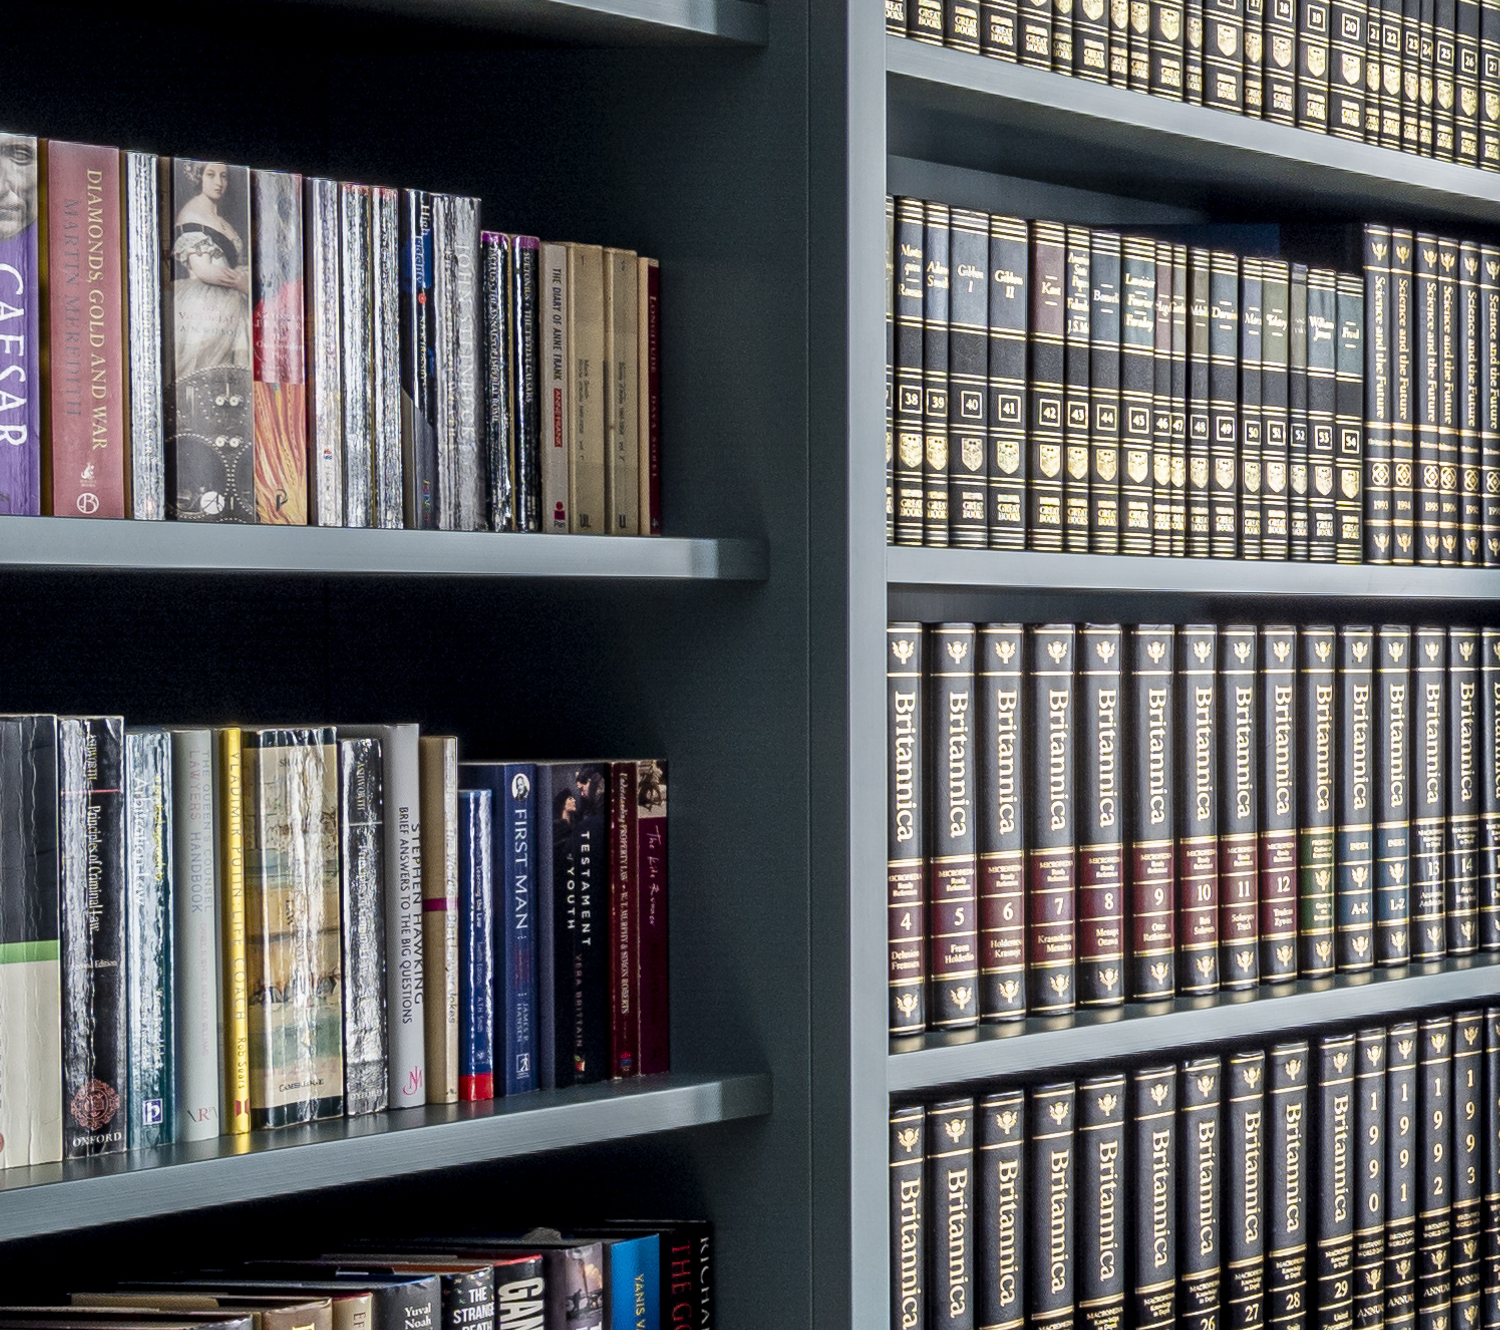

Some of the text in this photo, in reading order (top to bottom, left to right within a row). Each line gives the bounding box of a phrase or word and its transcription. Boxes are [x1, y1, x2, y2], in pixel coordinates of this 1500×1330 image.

[85, 170, 107, 450] DIAMONDS, GOLD AND WAR
[1372, 277, 1390, 420] Science and the Future
[948, 691, 970, 837] Britannica
[997, 689, 1018, 834] Britannica
[514, 808, 528, 929] FIRST MAN
[953, 907, 965, 926] 5
[1002, 901, 1015, 920] 6
[1048, 1149, 1069, 1293] Britannica
[1098, 1141, 1118, 1281] Britannica
